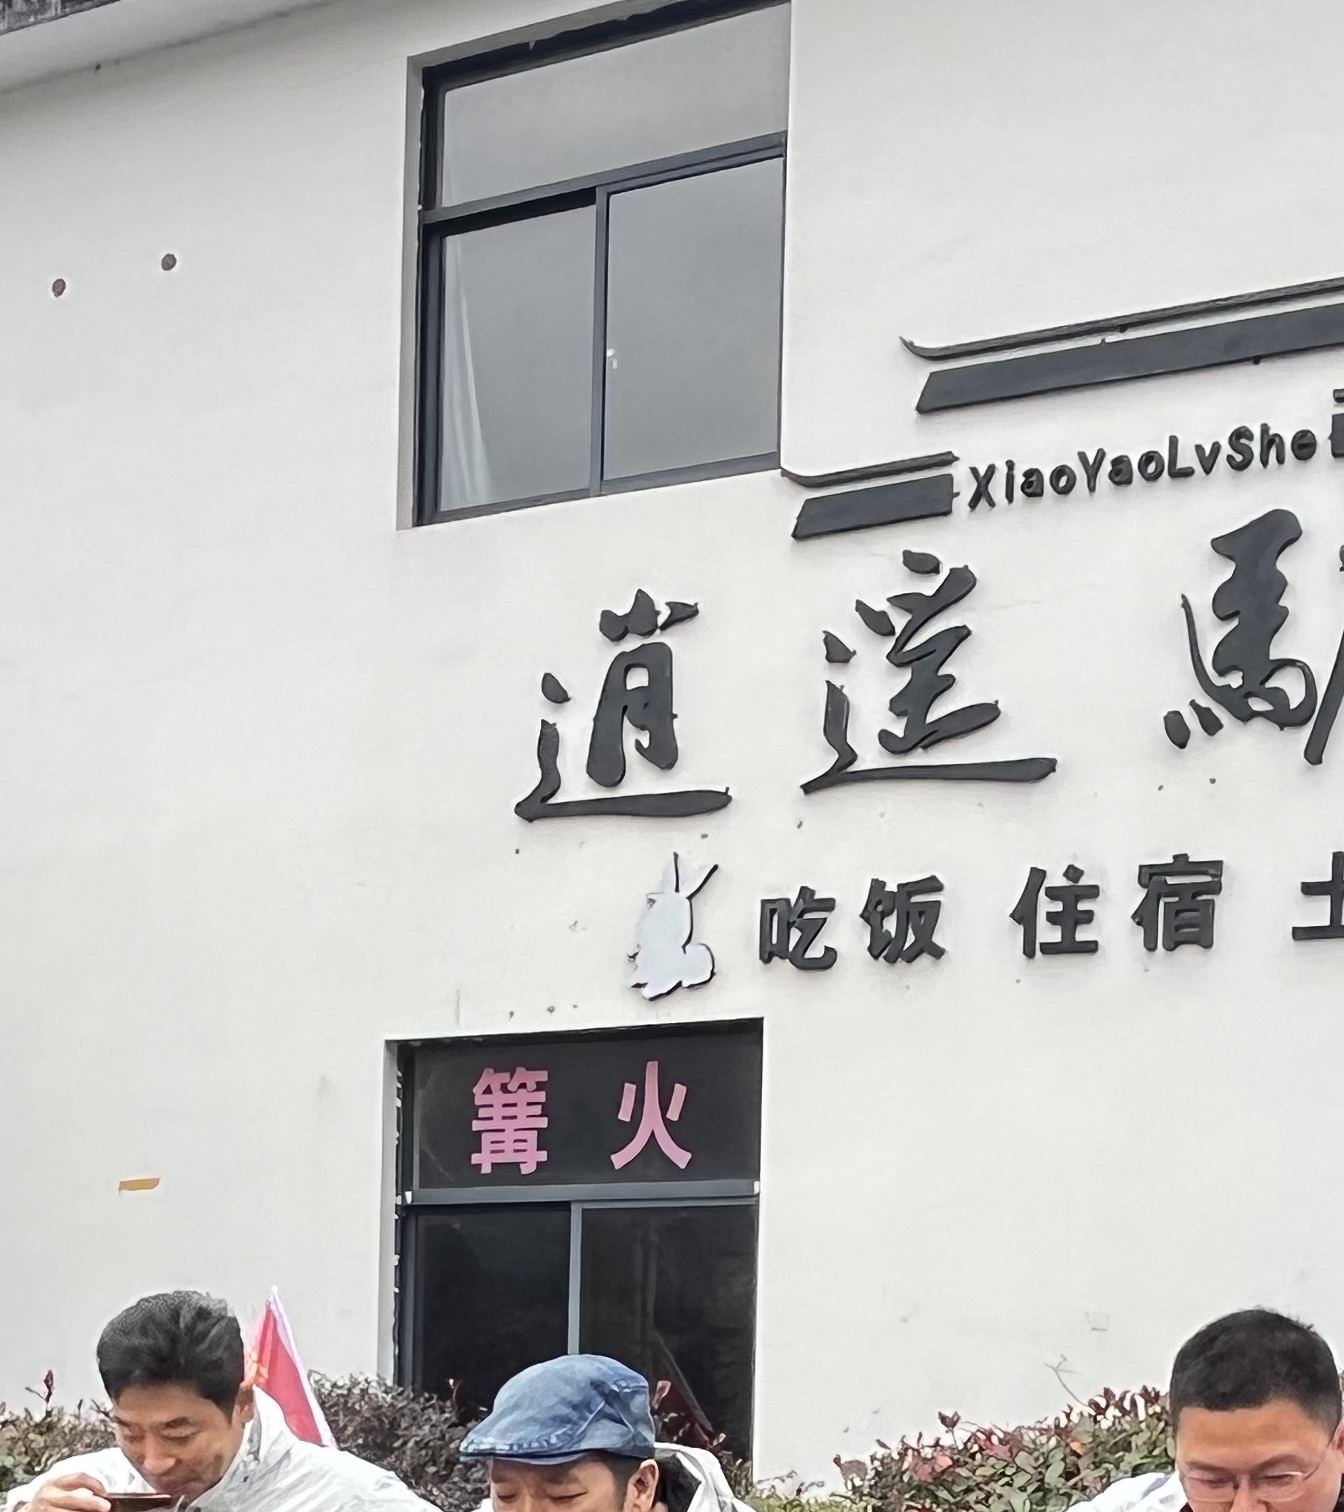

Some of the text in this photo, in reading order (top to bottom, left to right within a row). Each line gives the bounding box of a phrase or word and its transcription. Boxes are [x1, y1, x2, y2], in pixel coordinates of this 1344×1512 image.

[969, 424, 1317, 511] XiaoYaoLvShe
[759, 875, 946, 971] 吃饭
[1009, 854, 1224, 959] 住宿
[470, 1060, 692, 1175] 篝火
